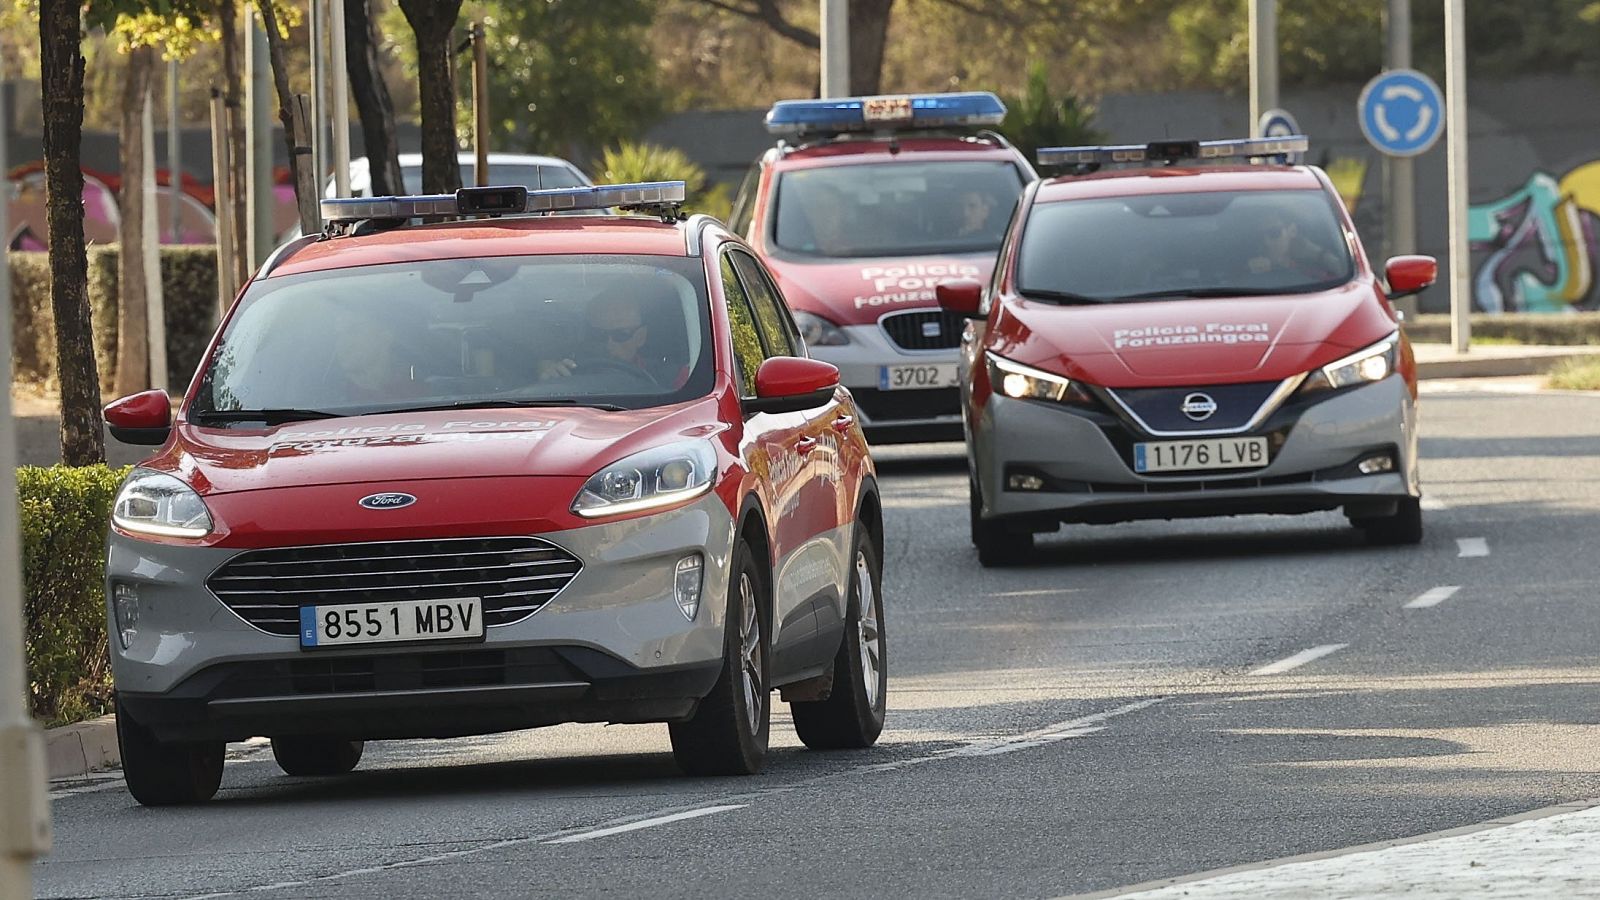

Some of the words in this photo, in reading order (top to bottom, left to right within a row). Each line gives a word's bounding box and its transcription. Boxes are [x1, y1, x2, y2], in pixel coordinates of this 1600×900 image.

[1205, 323, 1268, 333] Foral
[1114, 332, 1269, 349] Foruzaingoa
[893, 367, 938, 386] 3702
[442, 419, 557, 430] Foral
[1154, 444, 1209, 467] 1176
[1218, 442, 1261, 463] LVB
[372, 495, 403, 505] Ford
[325, 607, 400, 639] 8551
[415, 603, 474, 634] MBV
[305, 629, 313, 638] E
